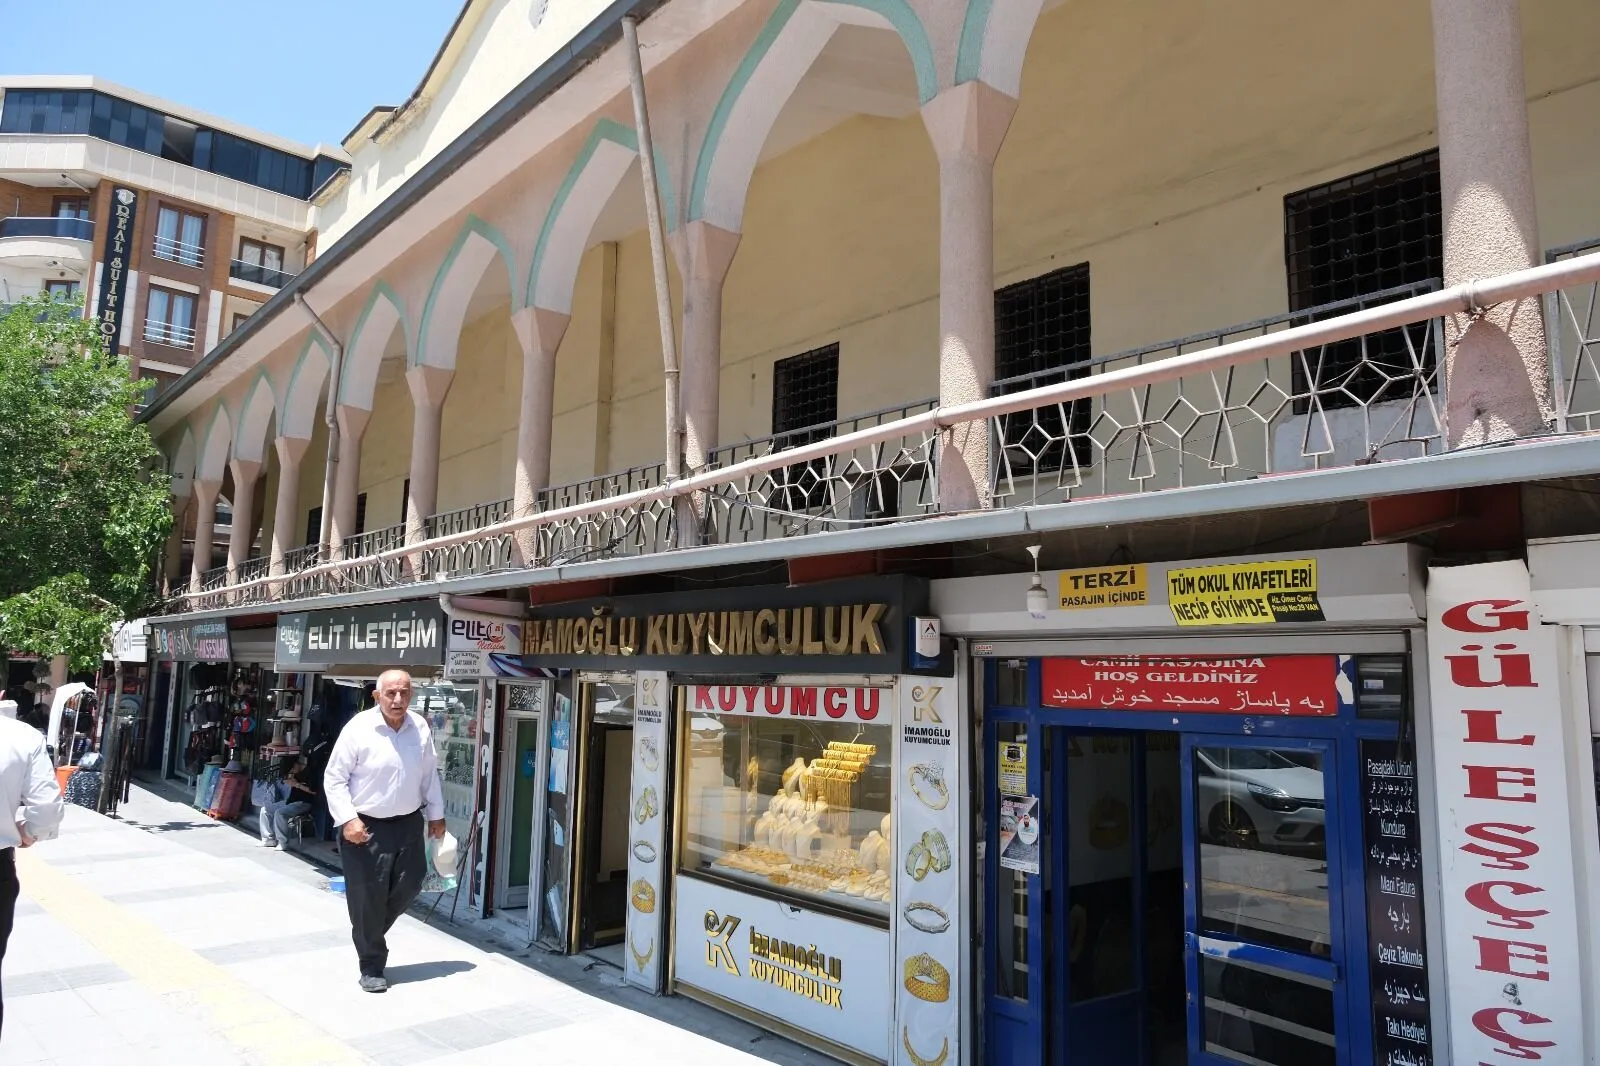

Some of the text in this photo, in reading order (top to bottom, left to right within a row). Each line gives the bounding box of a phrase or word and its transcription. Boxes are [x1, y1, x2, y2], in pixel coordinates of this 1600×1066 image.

[114, 205, 130, 253] REAL
[1069, 566, 1136, 590] TERZİ
[1171, 564, 1313, 596] TÜM OKUL KIYAFETLERİ
[1061, 591, 1145, 607] PASAJIN İÇİNDE
[1174, 594, 1268, 621] NECİP GİYİM'DE
[1305, 603, 1319, 611] VAN
[308, 611, 436, 658] ELİT İLETİŞİM
[646, 603, 888, 656] KUYUMCULUK
[1095, 669, 1258, 684] HOŞ GELDİNİZ
[696, 685, 880, 721] KUYUMCU
[1162, 692, 1219, 707] مسجد
[1230, 690, 1291, 714] پاساژ
[904, 725, 950, 737] İMAMOĞLU
[904, 736, 950, 746] KUYUMCULUK
[1381, 819, 1406, 836] Kundura
[1387, 904, 1410, 933] پارچه
[750, 925, 842, 984] İMAMOĞLU
[1378, 943, 1396, 964] Çeyiz
[750, 958, 842, 1010] KUYUMCULUK
[1386, 1016, 1400, 1035] Takı
